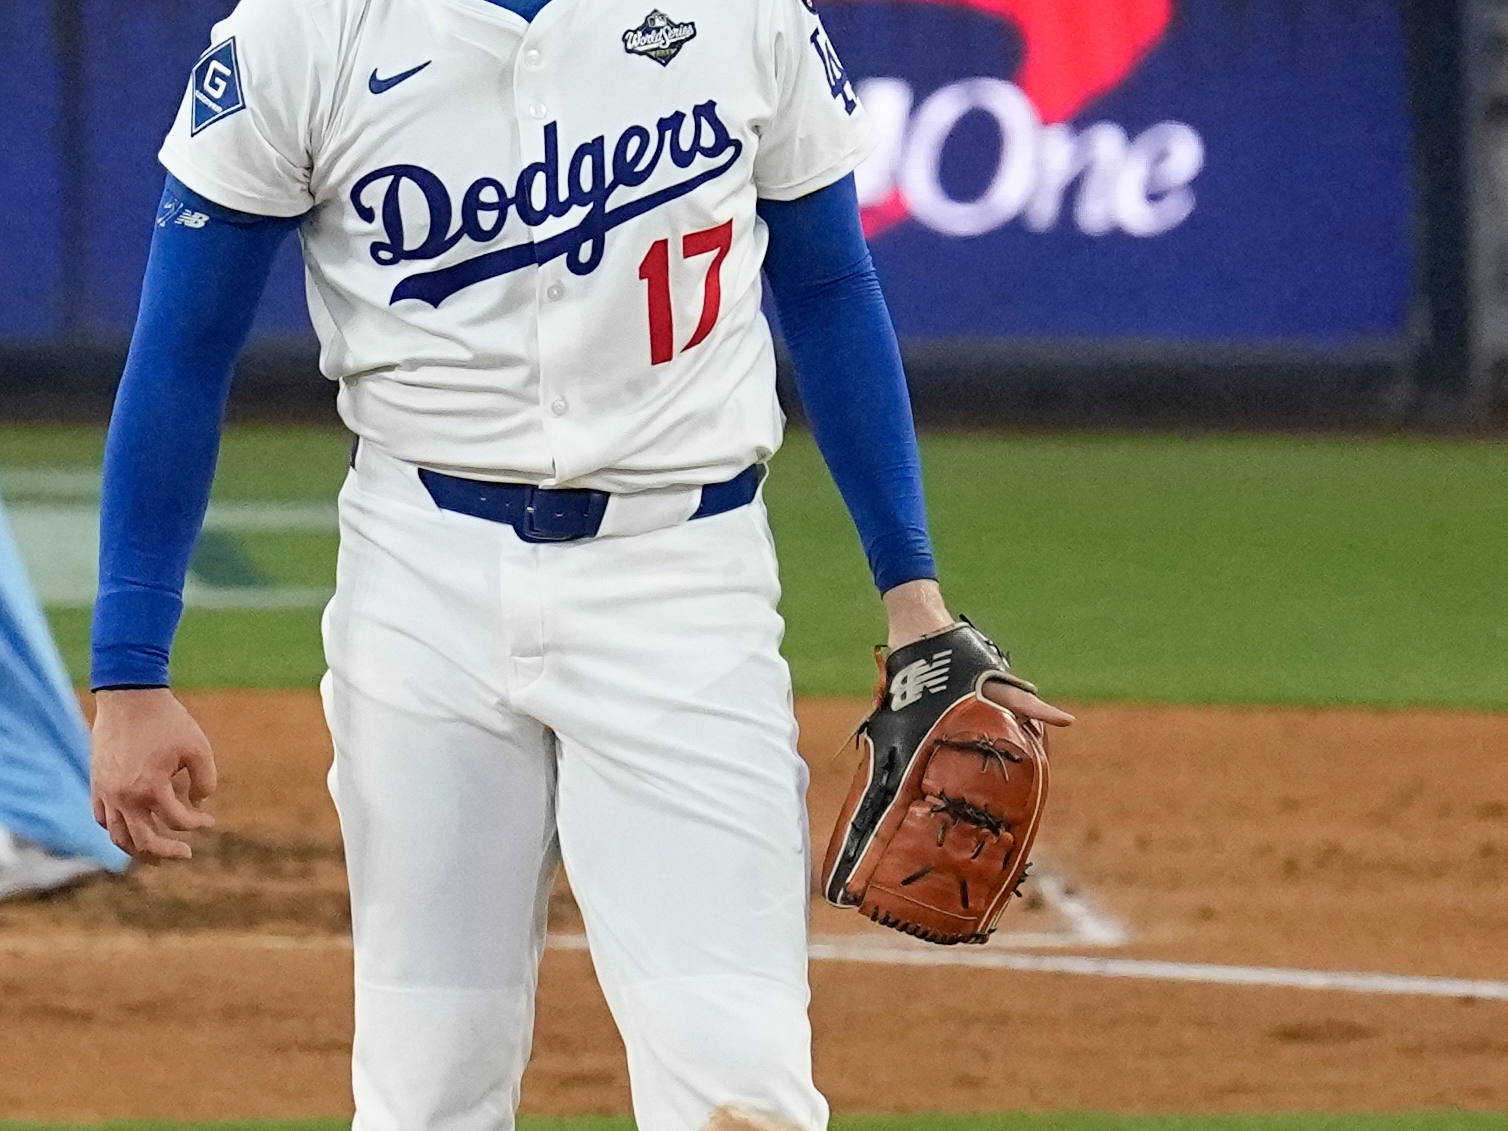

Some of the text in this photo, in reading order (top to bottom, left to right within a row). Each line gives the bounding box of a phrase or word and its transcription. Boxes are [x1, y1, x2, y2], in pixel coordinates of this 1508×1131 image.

[203, 59, 232, 100] G
[350, 99, 743, 279] Dodgers
[638, 219, 734, 367] 17
